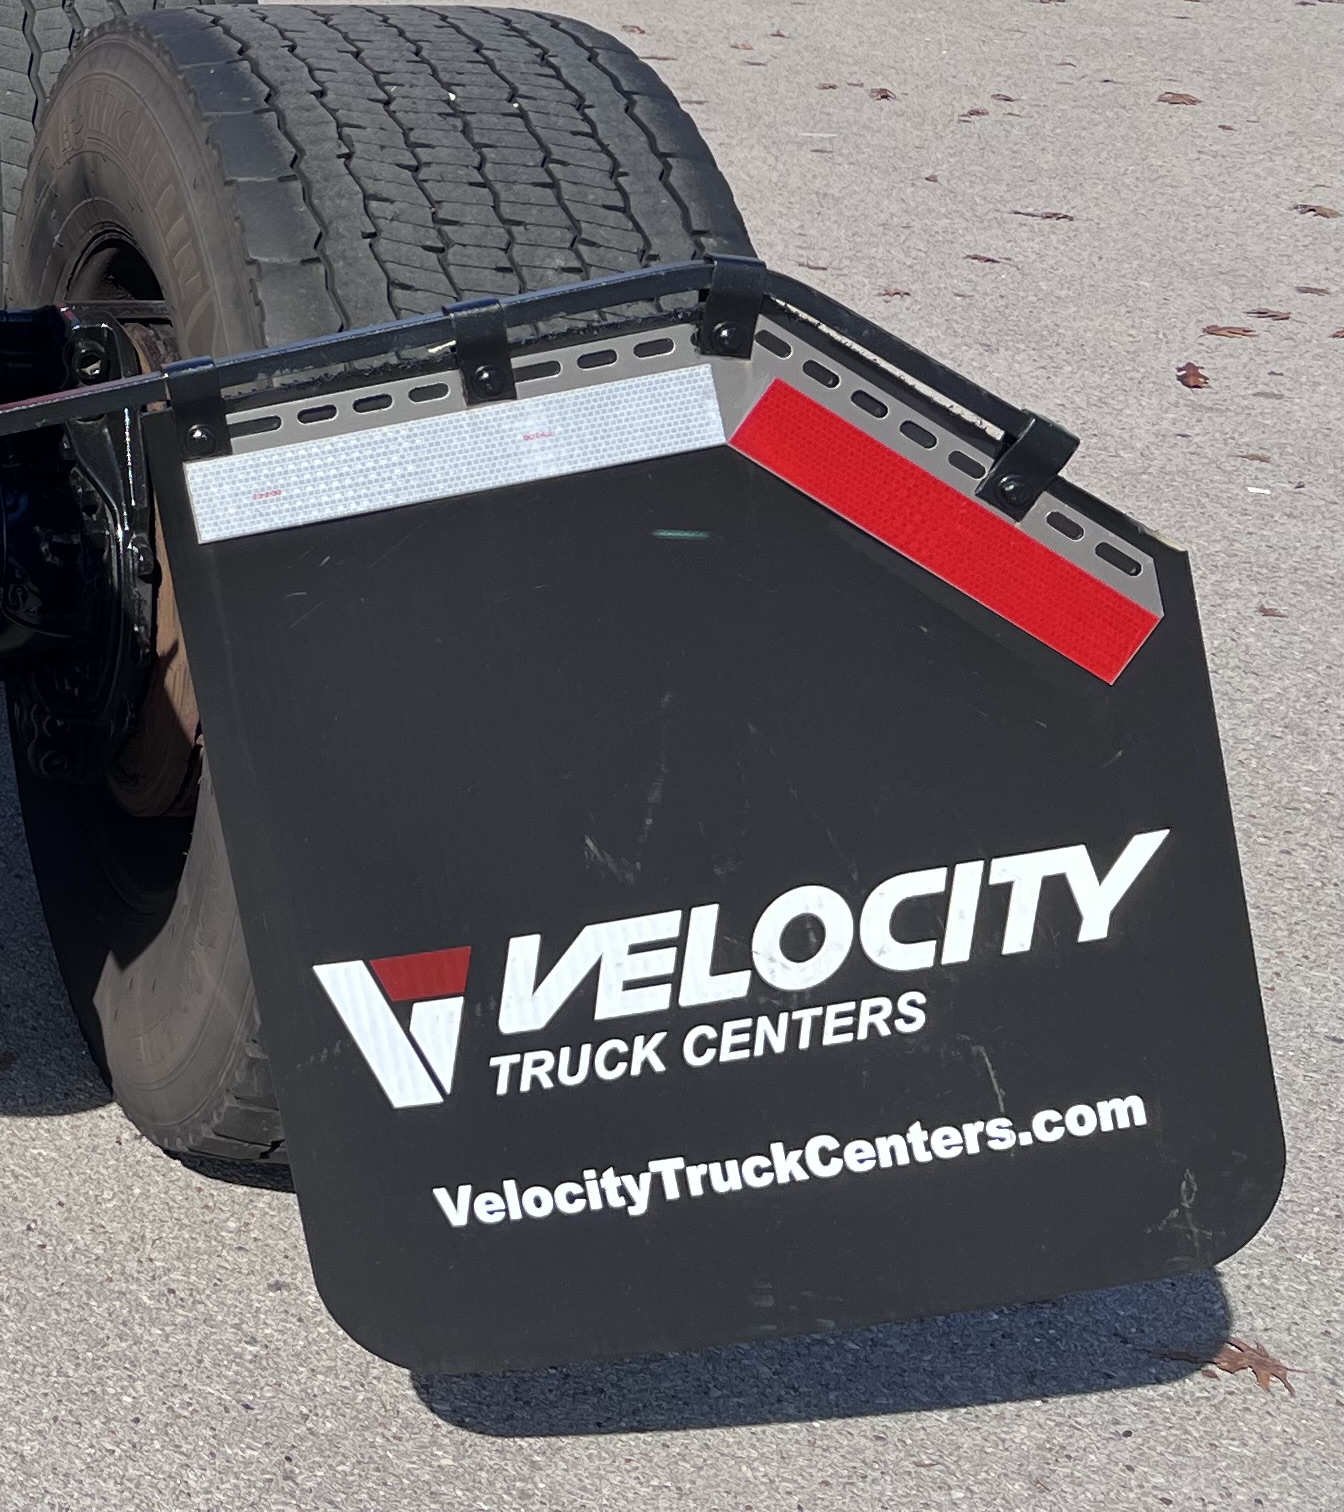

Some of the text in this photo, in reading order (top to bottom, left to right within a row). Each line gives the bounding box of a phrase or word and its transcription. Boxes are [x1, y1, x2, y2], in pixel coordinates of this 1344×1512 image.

[498, 829, 1170, 1035] VELOCITY
[490, 991, 928, 1096] TRUCK CENTERS
[433, 1095, 1147, 1227] VelocityTruckCenters.com
